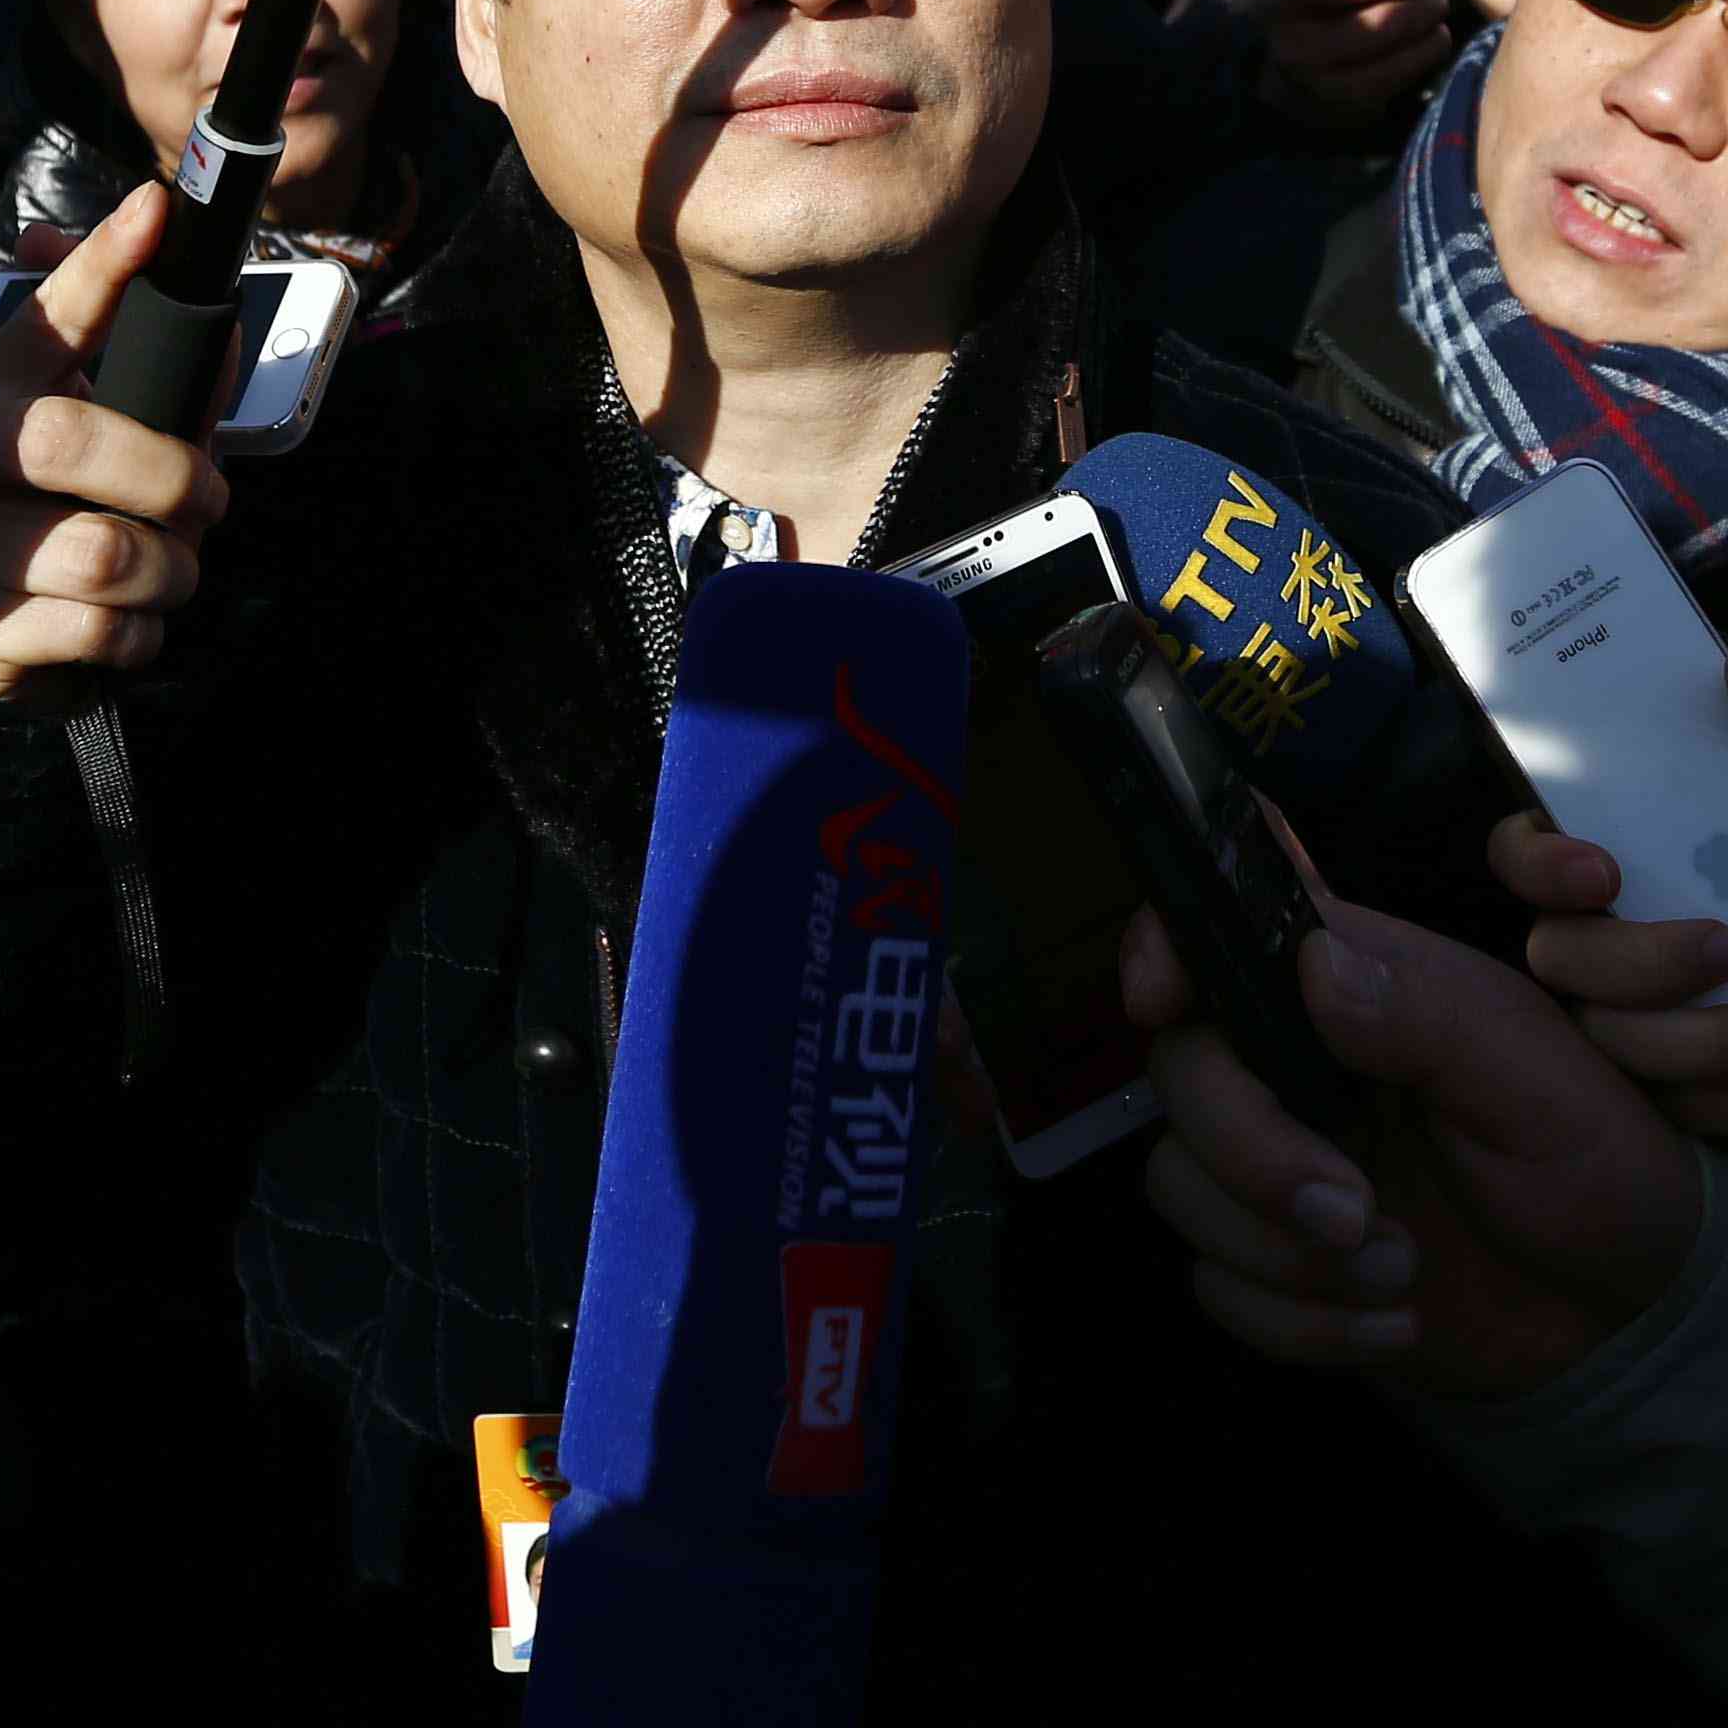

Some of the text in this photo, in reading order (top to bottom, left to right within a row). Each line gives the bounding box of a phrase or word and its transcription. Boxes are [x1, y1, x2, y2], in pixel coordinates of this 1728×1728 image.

[934, 558, 992, 592] MSUNG
[1201, 528, 1374, 757] 東森
[1556, 623, 1612, 663] iPhone
[776, 870, 841, 1232] PEOPLE TELEVISION
